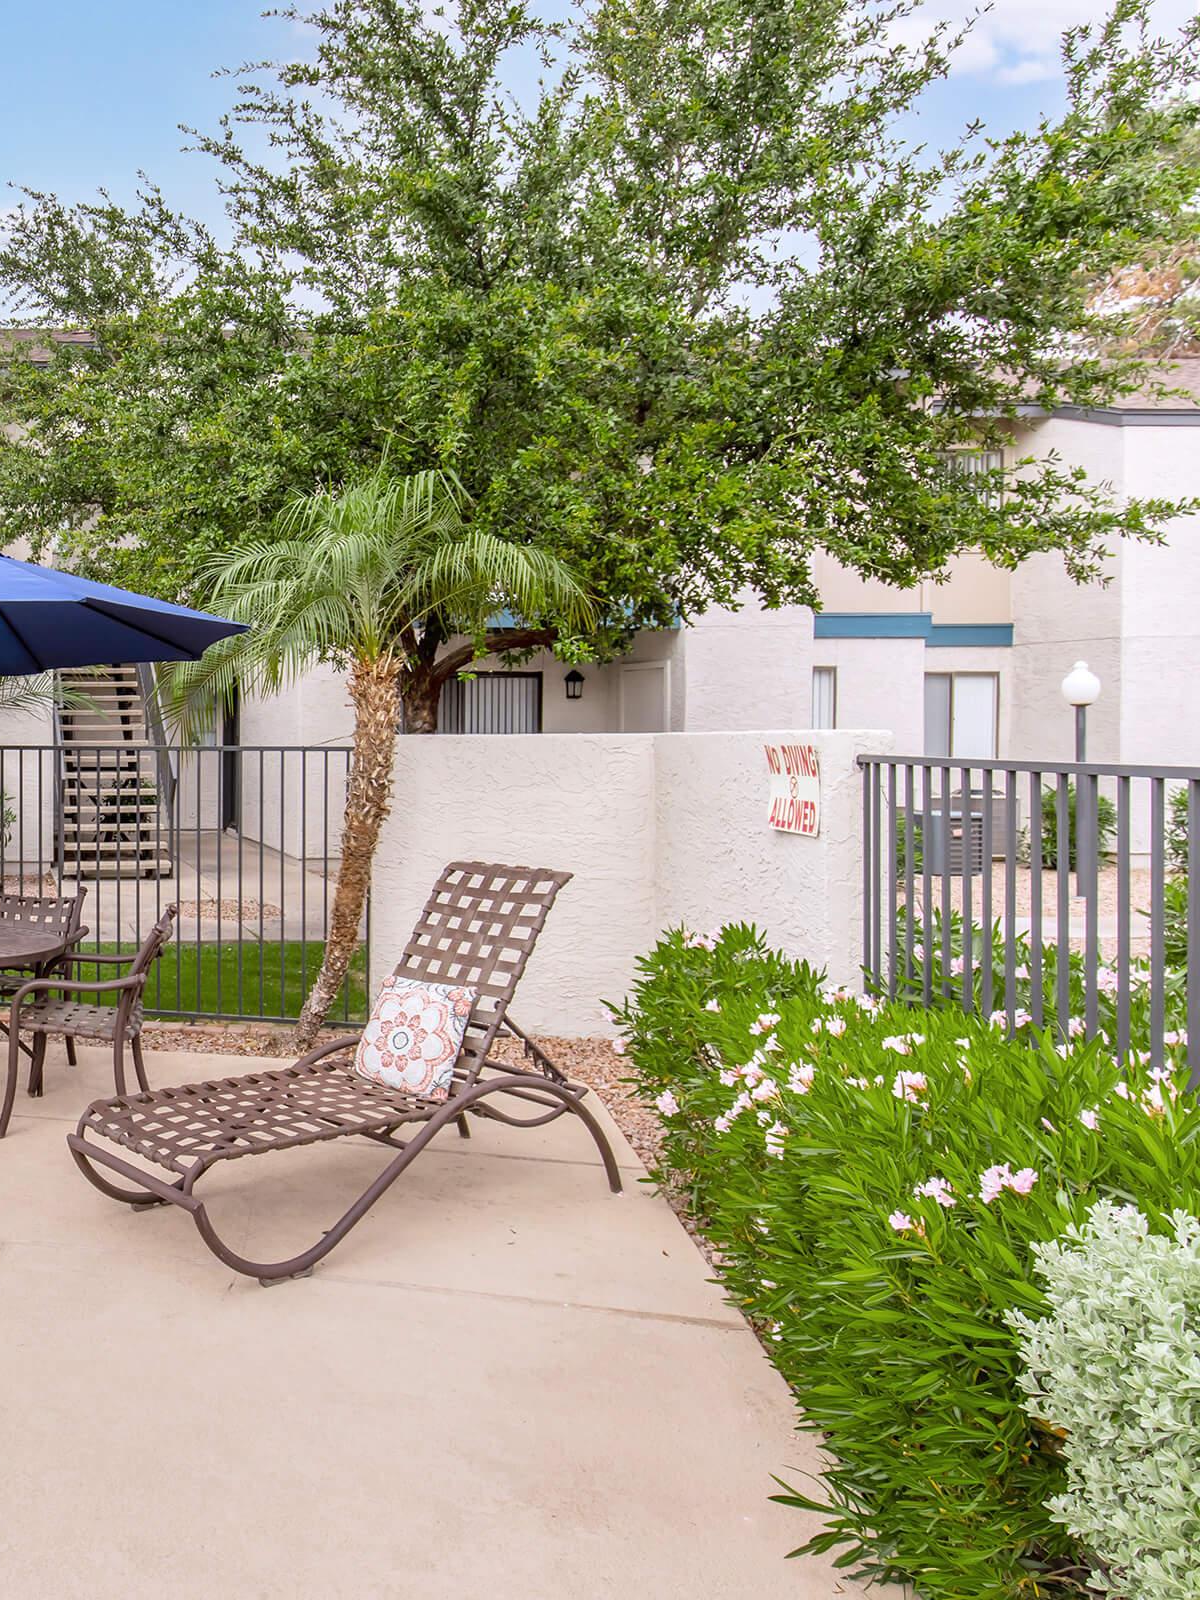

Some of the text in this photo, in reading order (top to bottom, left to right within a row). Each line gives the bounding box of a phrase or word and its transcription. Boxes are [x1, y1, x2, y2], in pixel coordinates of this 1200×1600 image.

[764, 745, 817, 777] NO DIVING
[769, 797, 816, 833] ALLOWED
